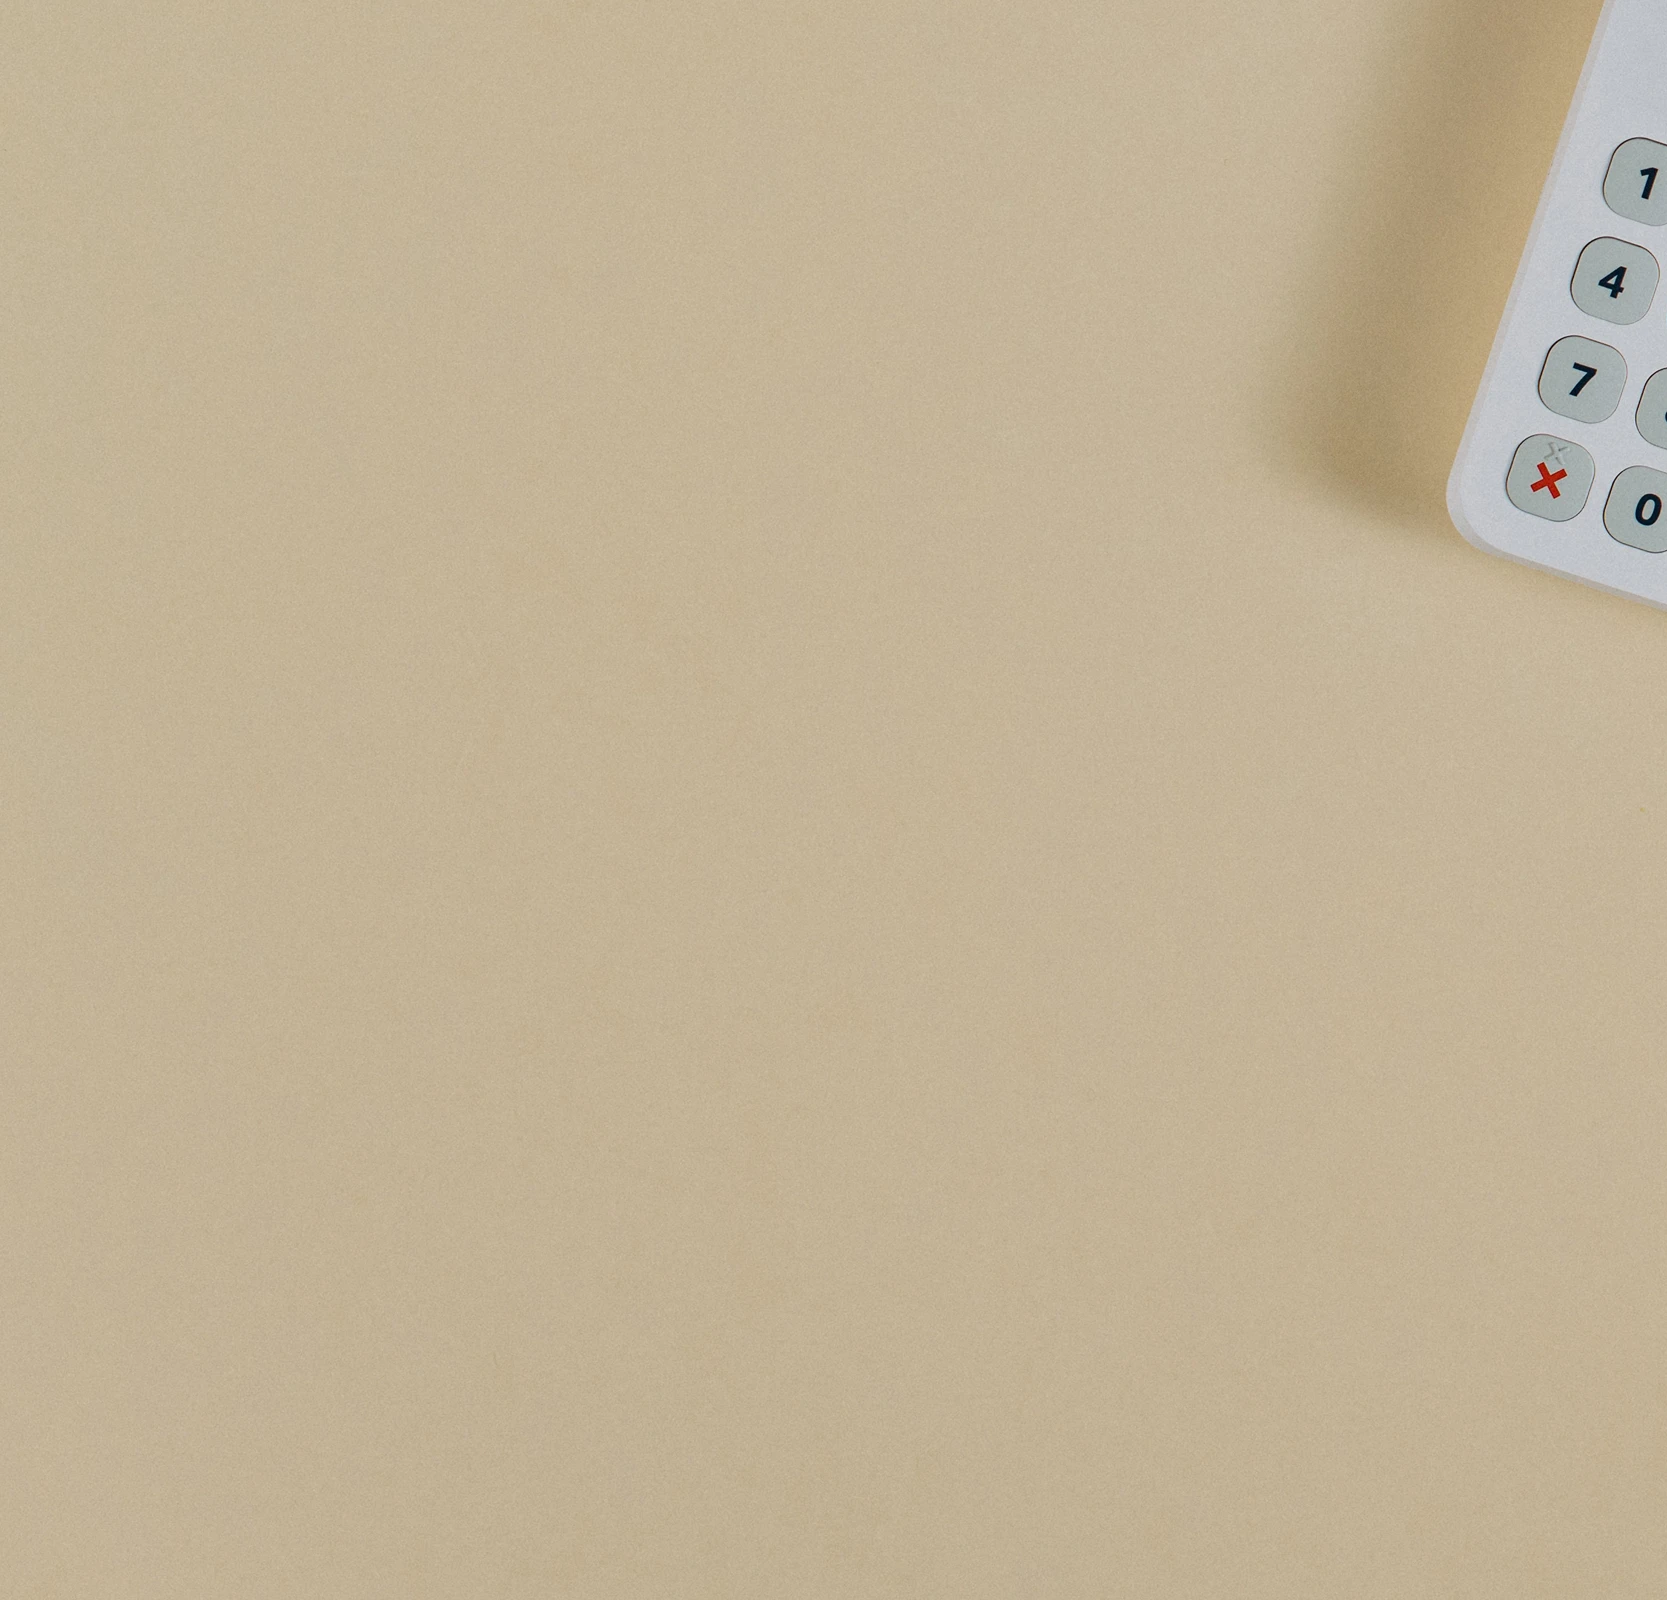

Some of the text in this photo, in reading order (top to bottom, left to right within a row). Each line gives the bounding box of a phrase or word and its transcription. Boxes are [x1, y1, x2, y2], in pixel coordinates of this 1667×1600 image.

[1640, 167, 1659, 200] 1
[1597, 265, 1628, 299] 4
[1568, 361, 1598, 397] 7
[1635, 493, 1662, 526] 0
